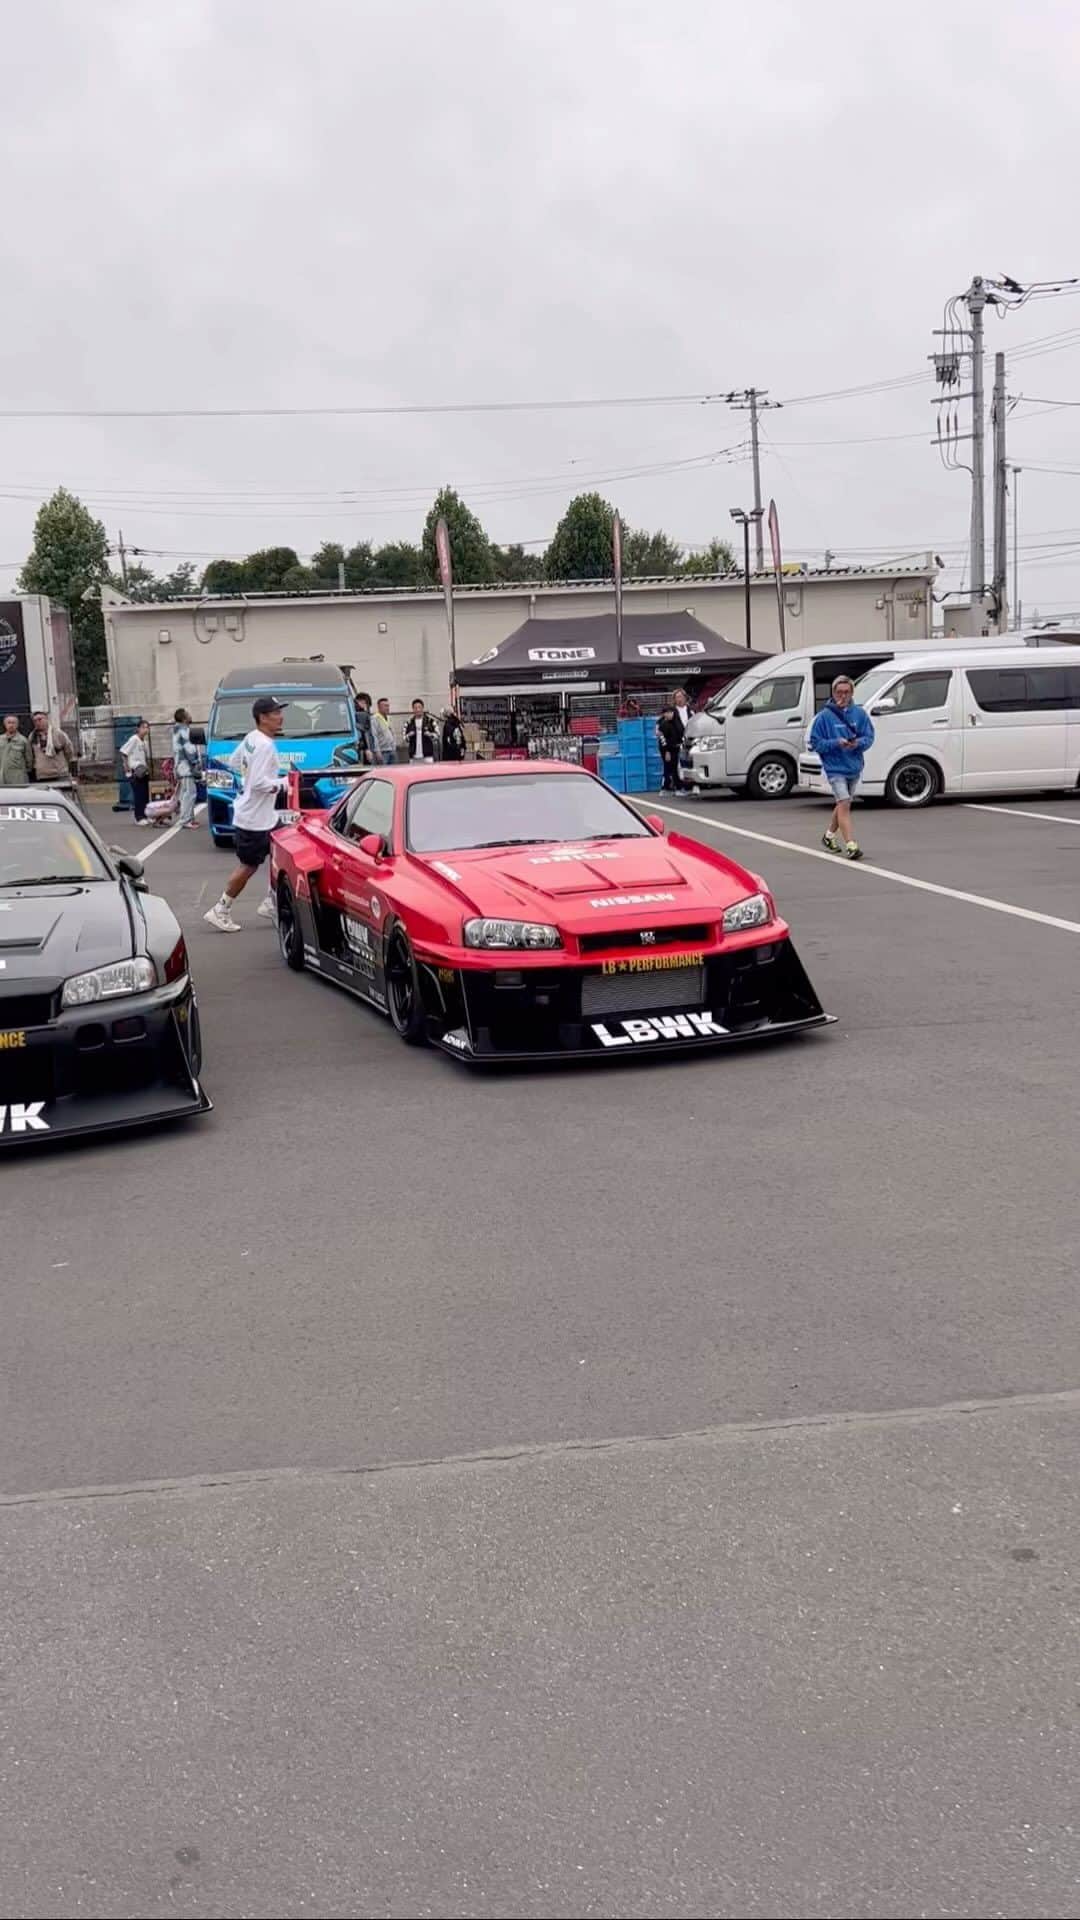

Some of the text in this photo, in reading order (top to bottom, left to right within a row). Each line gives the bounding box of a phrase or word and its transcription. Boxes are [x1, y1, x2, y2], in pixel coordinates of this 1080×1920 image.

[533, 649, 589, 660] TONE
[644, 642, 700, 655] TONE
[589, 893, 675, 908] NISSAN
[602, 951, 704, 975] LB PERFORMANCE
[590, 1011, 731, 1048] LBWK
